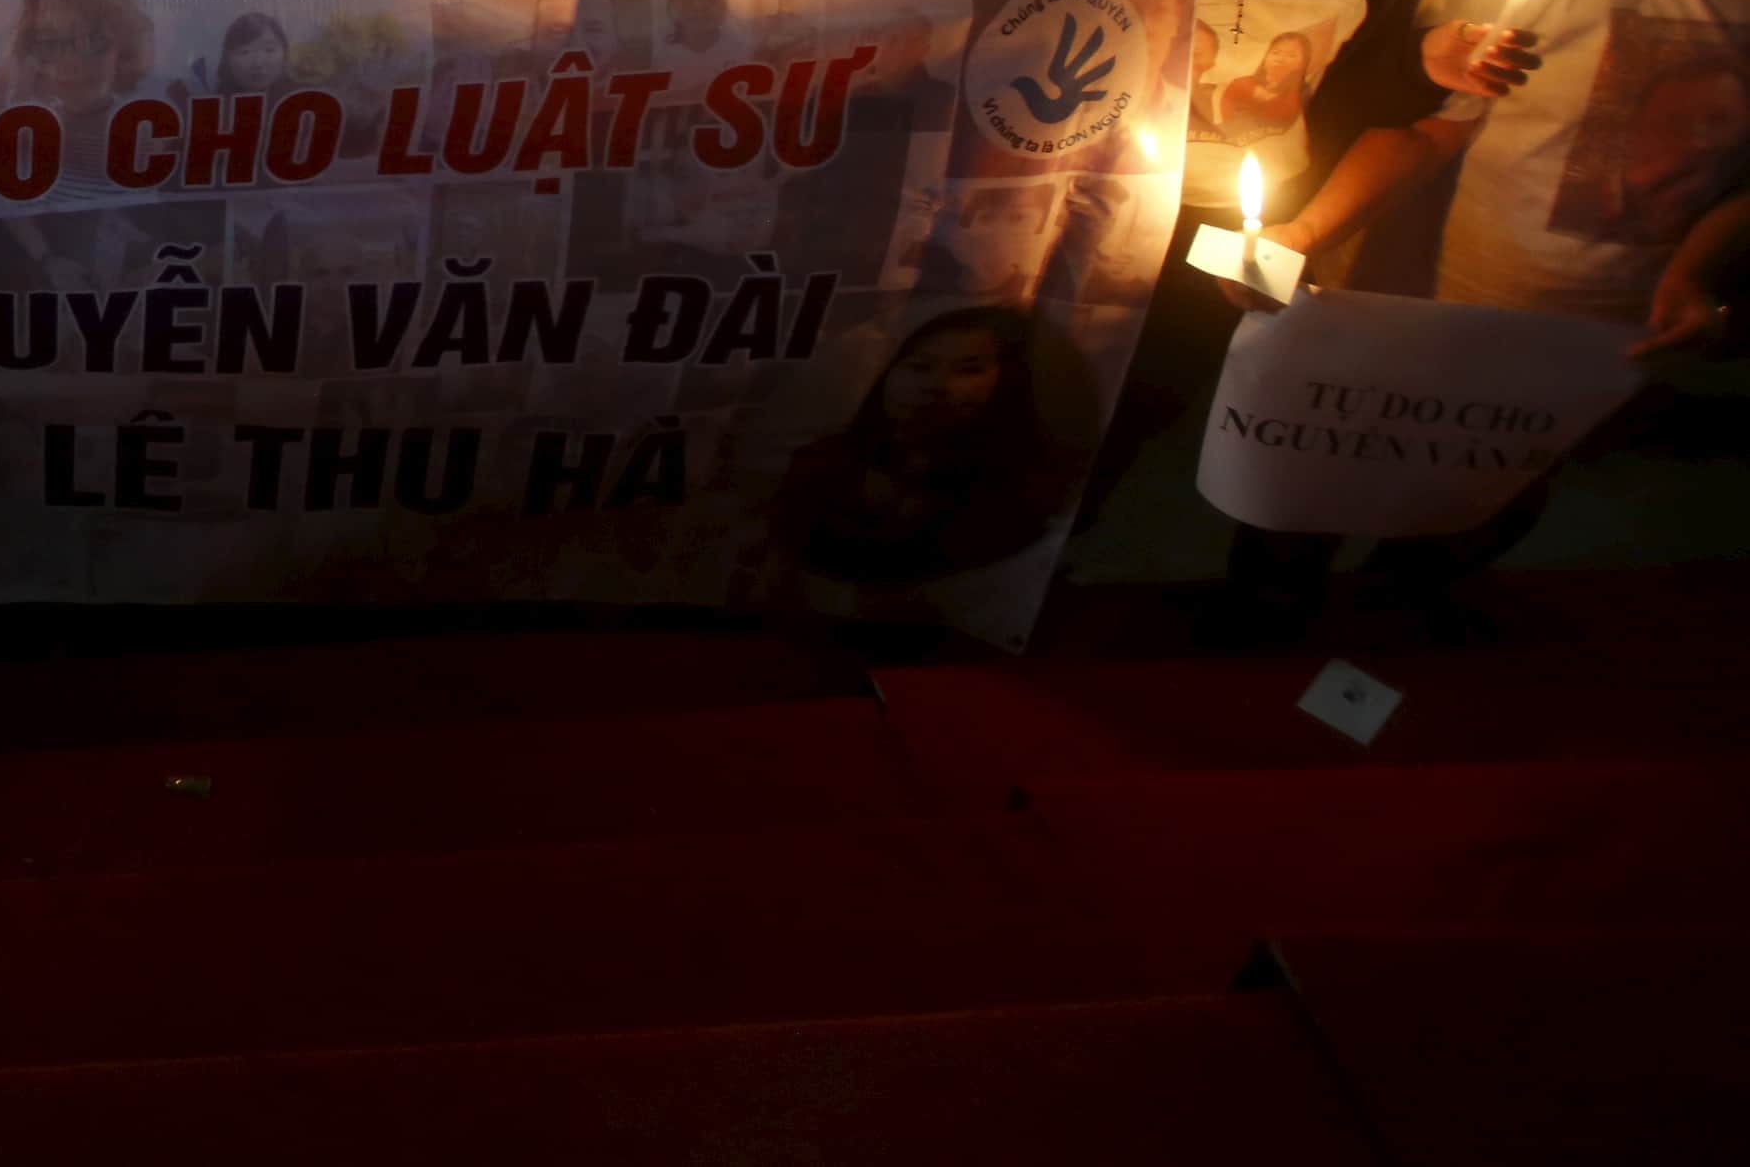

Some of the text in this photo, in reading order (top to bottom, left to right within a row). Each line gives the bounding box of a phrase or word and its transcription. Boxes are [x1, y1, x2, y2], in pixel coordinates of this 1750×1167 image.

[106, 90, 343, 188] CHO
[377, 50, 672, 195] LUẬT
[694, 45, 878, 169] SƯ
[1025, 139, 1038, 153] ta
[1041, 140, 1054, 154] là
[1057, 130, 1088, 151] CON
[348, 257, 594, 370] VĂN
[623, 253, 842, 365] ĐÀI
[45, 410, 687, 517] LÊ THU HÀ
[1380, 392, 1445, 424] DO
[1456, 402, 1555, 433] CHO
